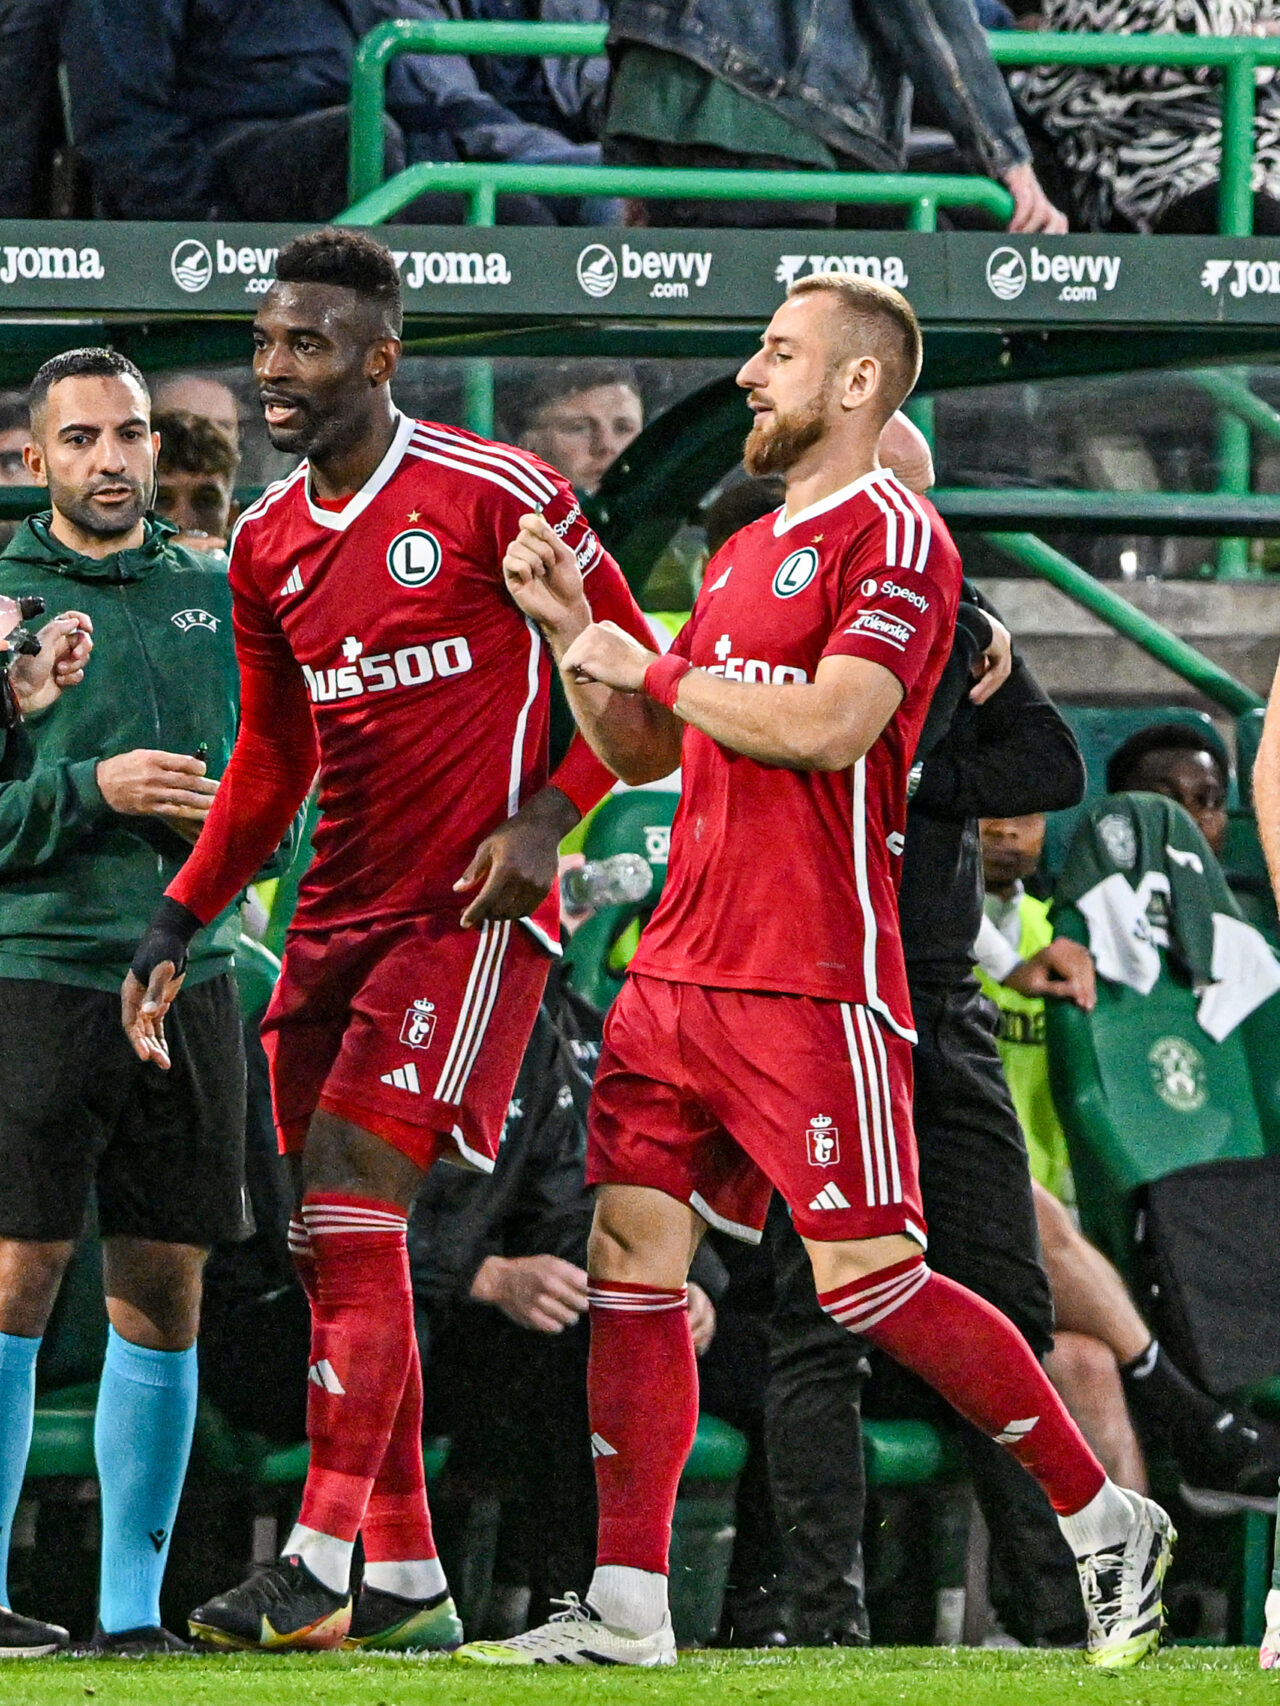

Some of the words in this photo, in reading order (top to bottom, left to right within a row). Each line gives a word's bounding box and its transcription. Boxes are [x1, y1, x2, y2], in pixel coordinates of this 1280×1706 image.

[216, 239, 280, 274] bev
[621, 243, 712, 287] bevvy
[1030, 247, 1121, 291] bevvy
[244, 278, 277, 294] .co
[649, 282, 689, 299] .com
[1058, 286, 1098, 301] .com
[404, 542, 426, 575] L
[783, 557, 801, 587] L
[880, 580, 929, 614] Speedy
[173, 612, 217, 630] UEFA
[301, 636, 473, 702] lus500
